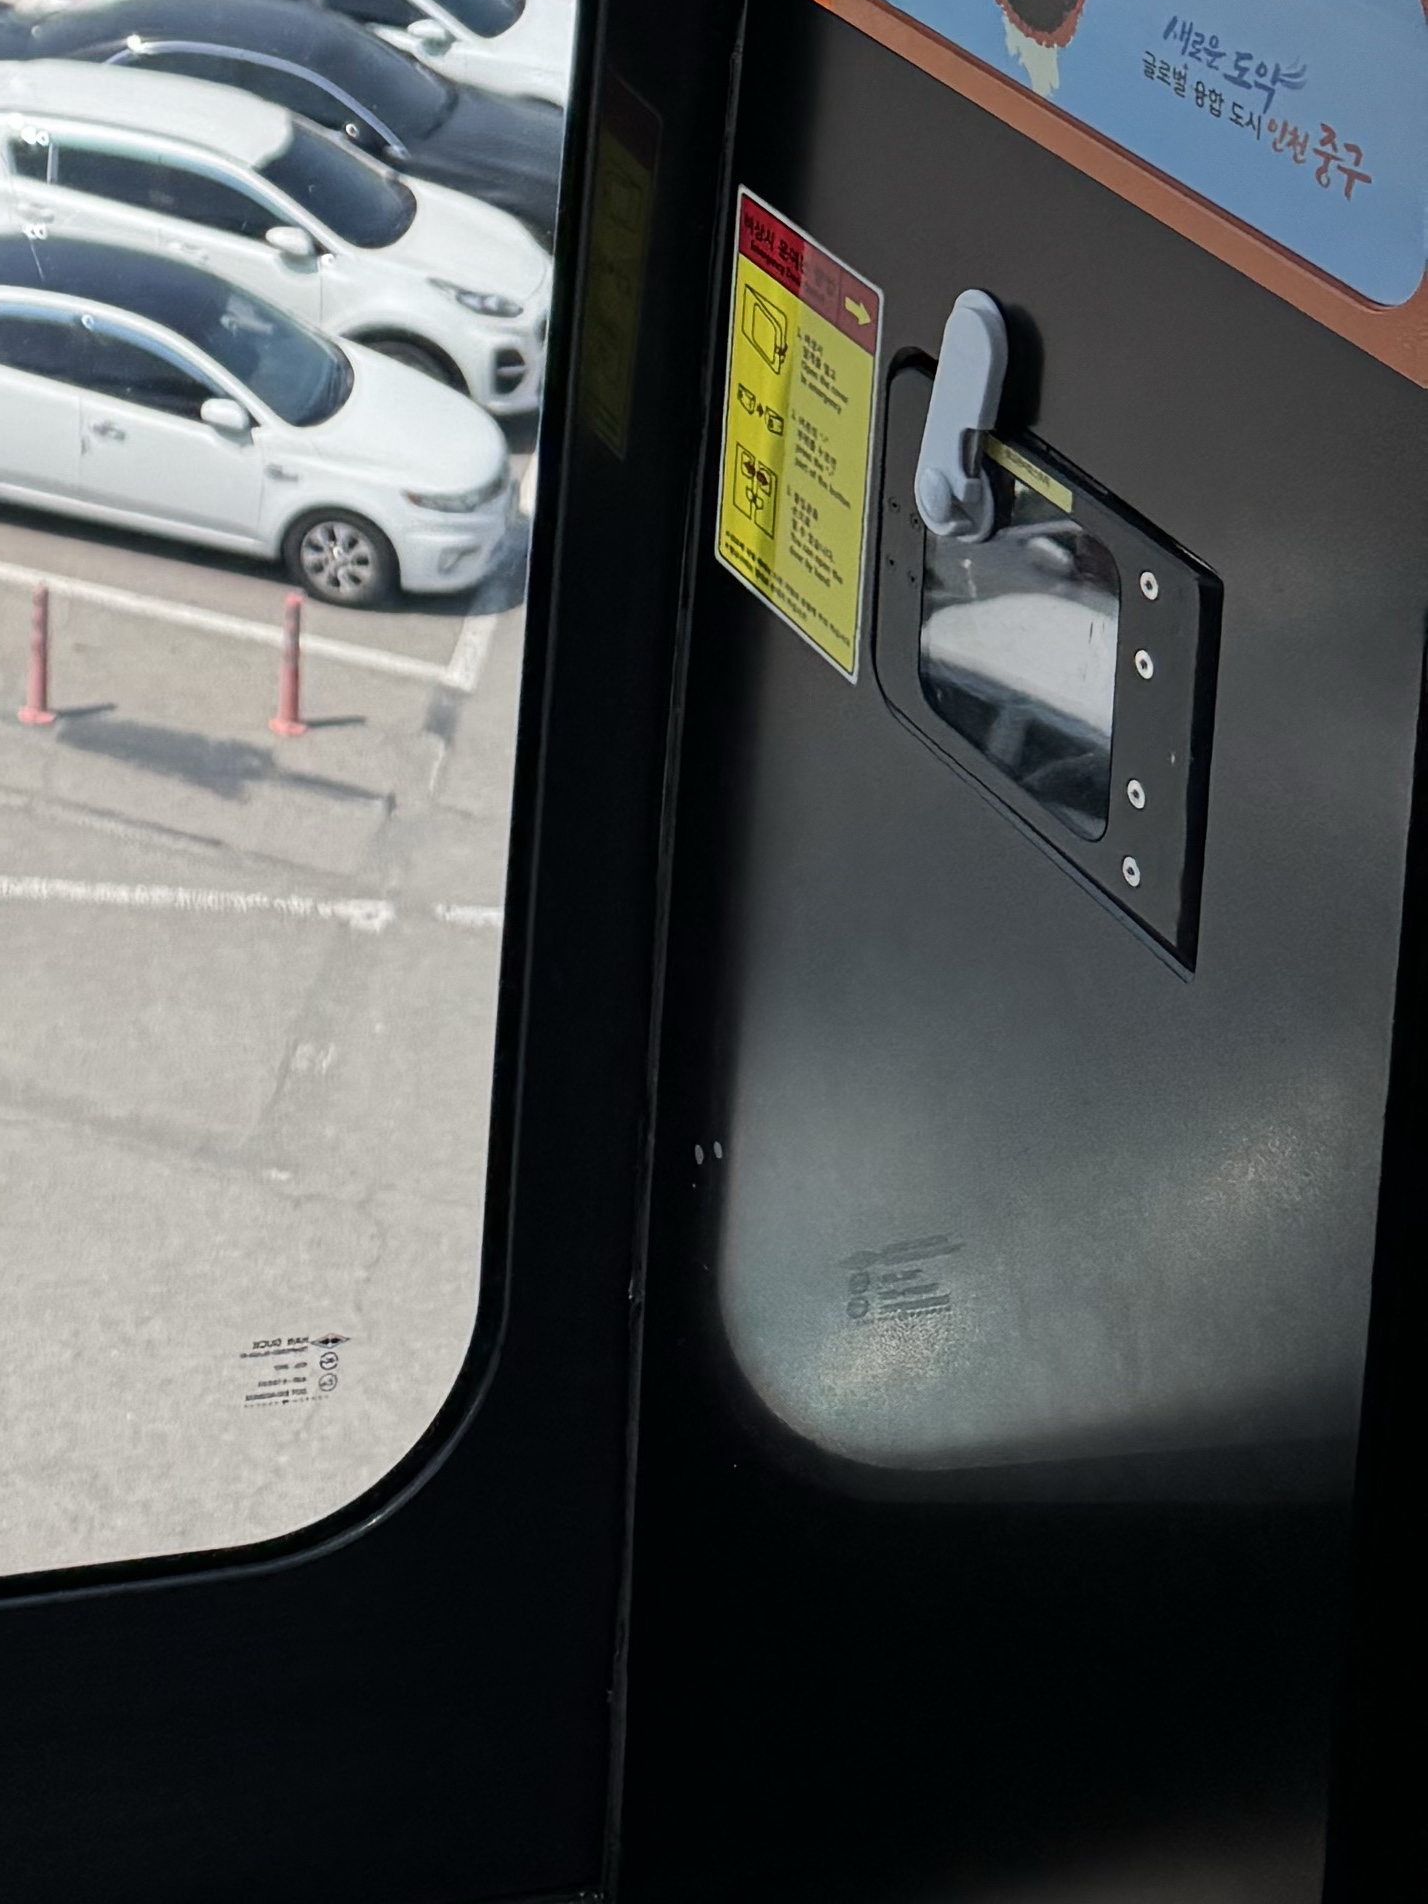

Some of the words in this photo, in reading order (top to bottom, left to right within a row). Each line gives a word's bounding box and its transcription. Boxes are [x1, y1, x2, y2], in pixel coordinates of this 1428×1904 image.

[1142, 51, 1189, 98] 글로벌
[1194, 80, 1224, 119] 융합
[1229, 102, 1262, 141] 도시
[1267, 118, 1310, 165] 인천
[1312, 123, 1372, 201] 중구
[1163, 15, 1226, 71] 새로운
[1222, 51, 1307, 114] 도약
